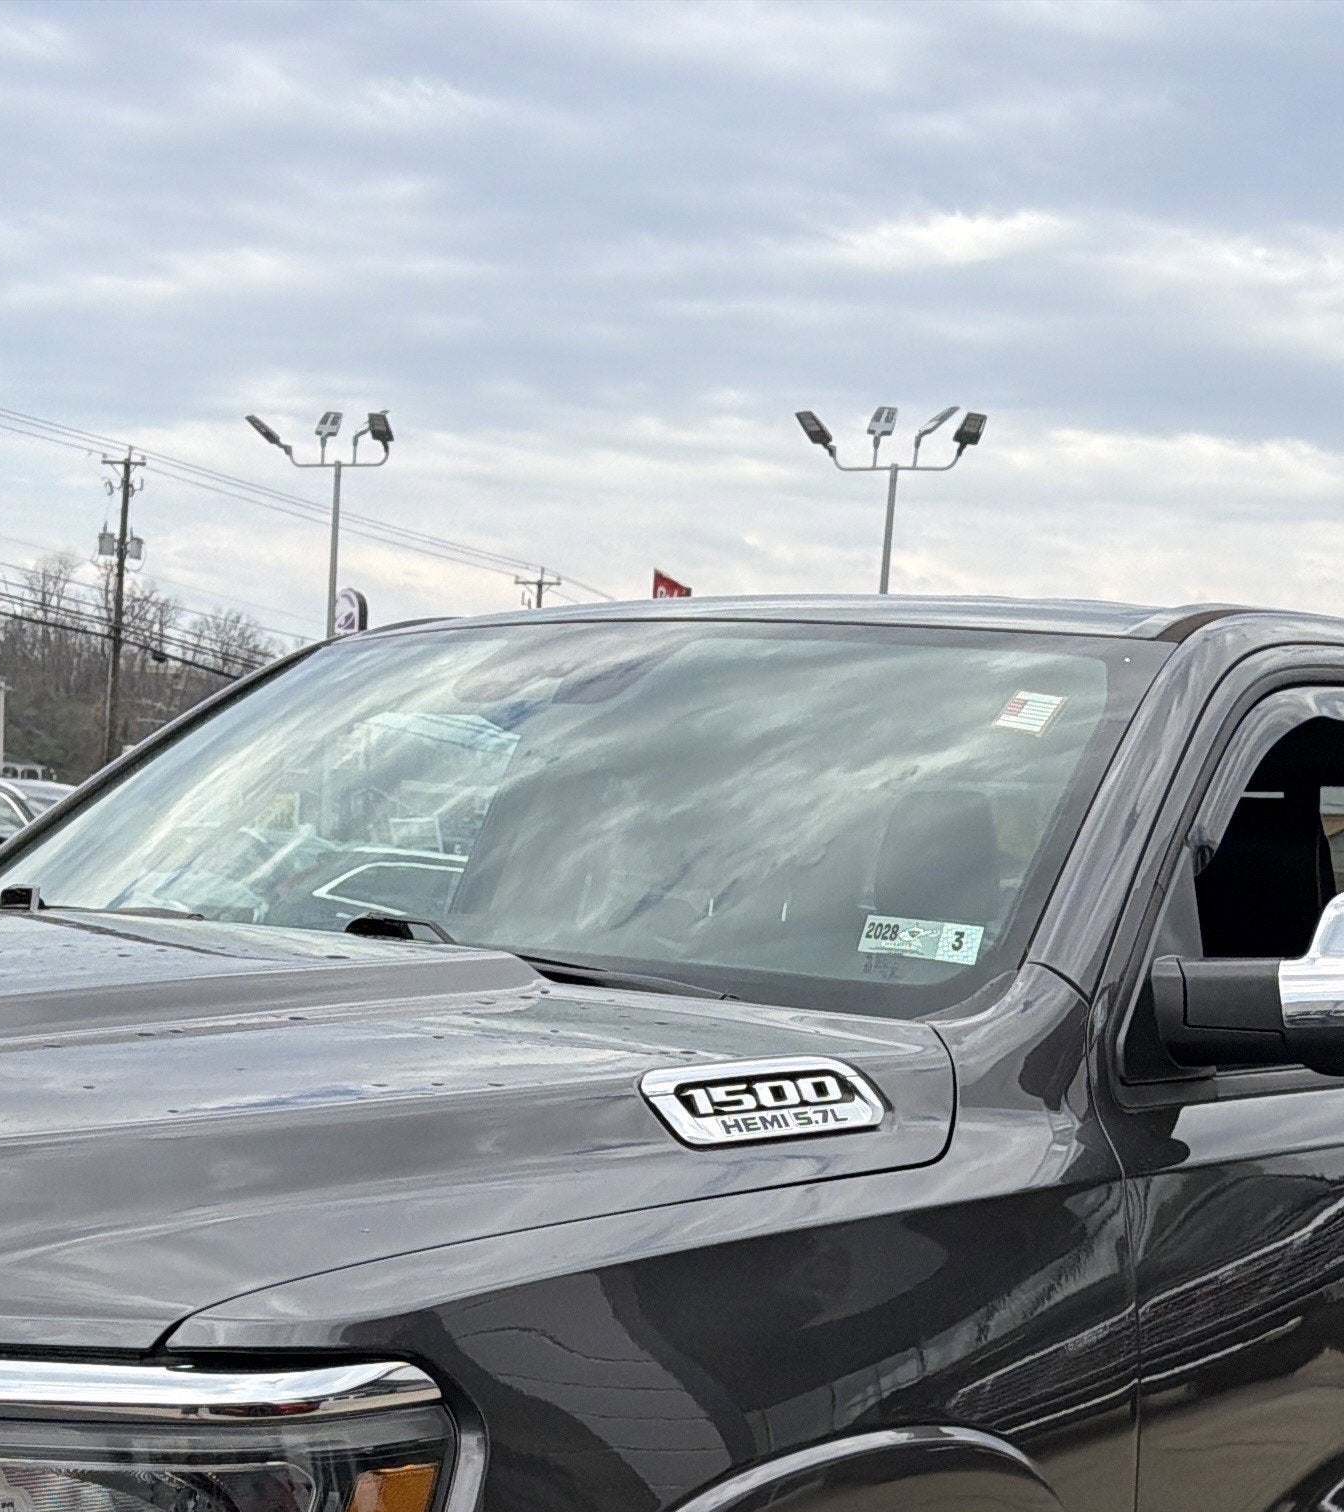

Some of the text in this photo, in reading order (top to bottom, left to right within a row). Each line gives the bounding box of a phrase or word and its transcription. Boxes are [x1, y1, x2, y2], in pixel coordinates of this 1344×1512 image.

[864, 922, 965, 951] 2028 3
[680, 1075, 843, 1115] 1500
[720, 1107, 849, 1135] HEMI 5.7L
